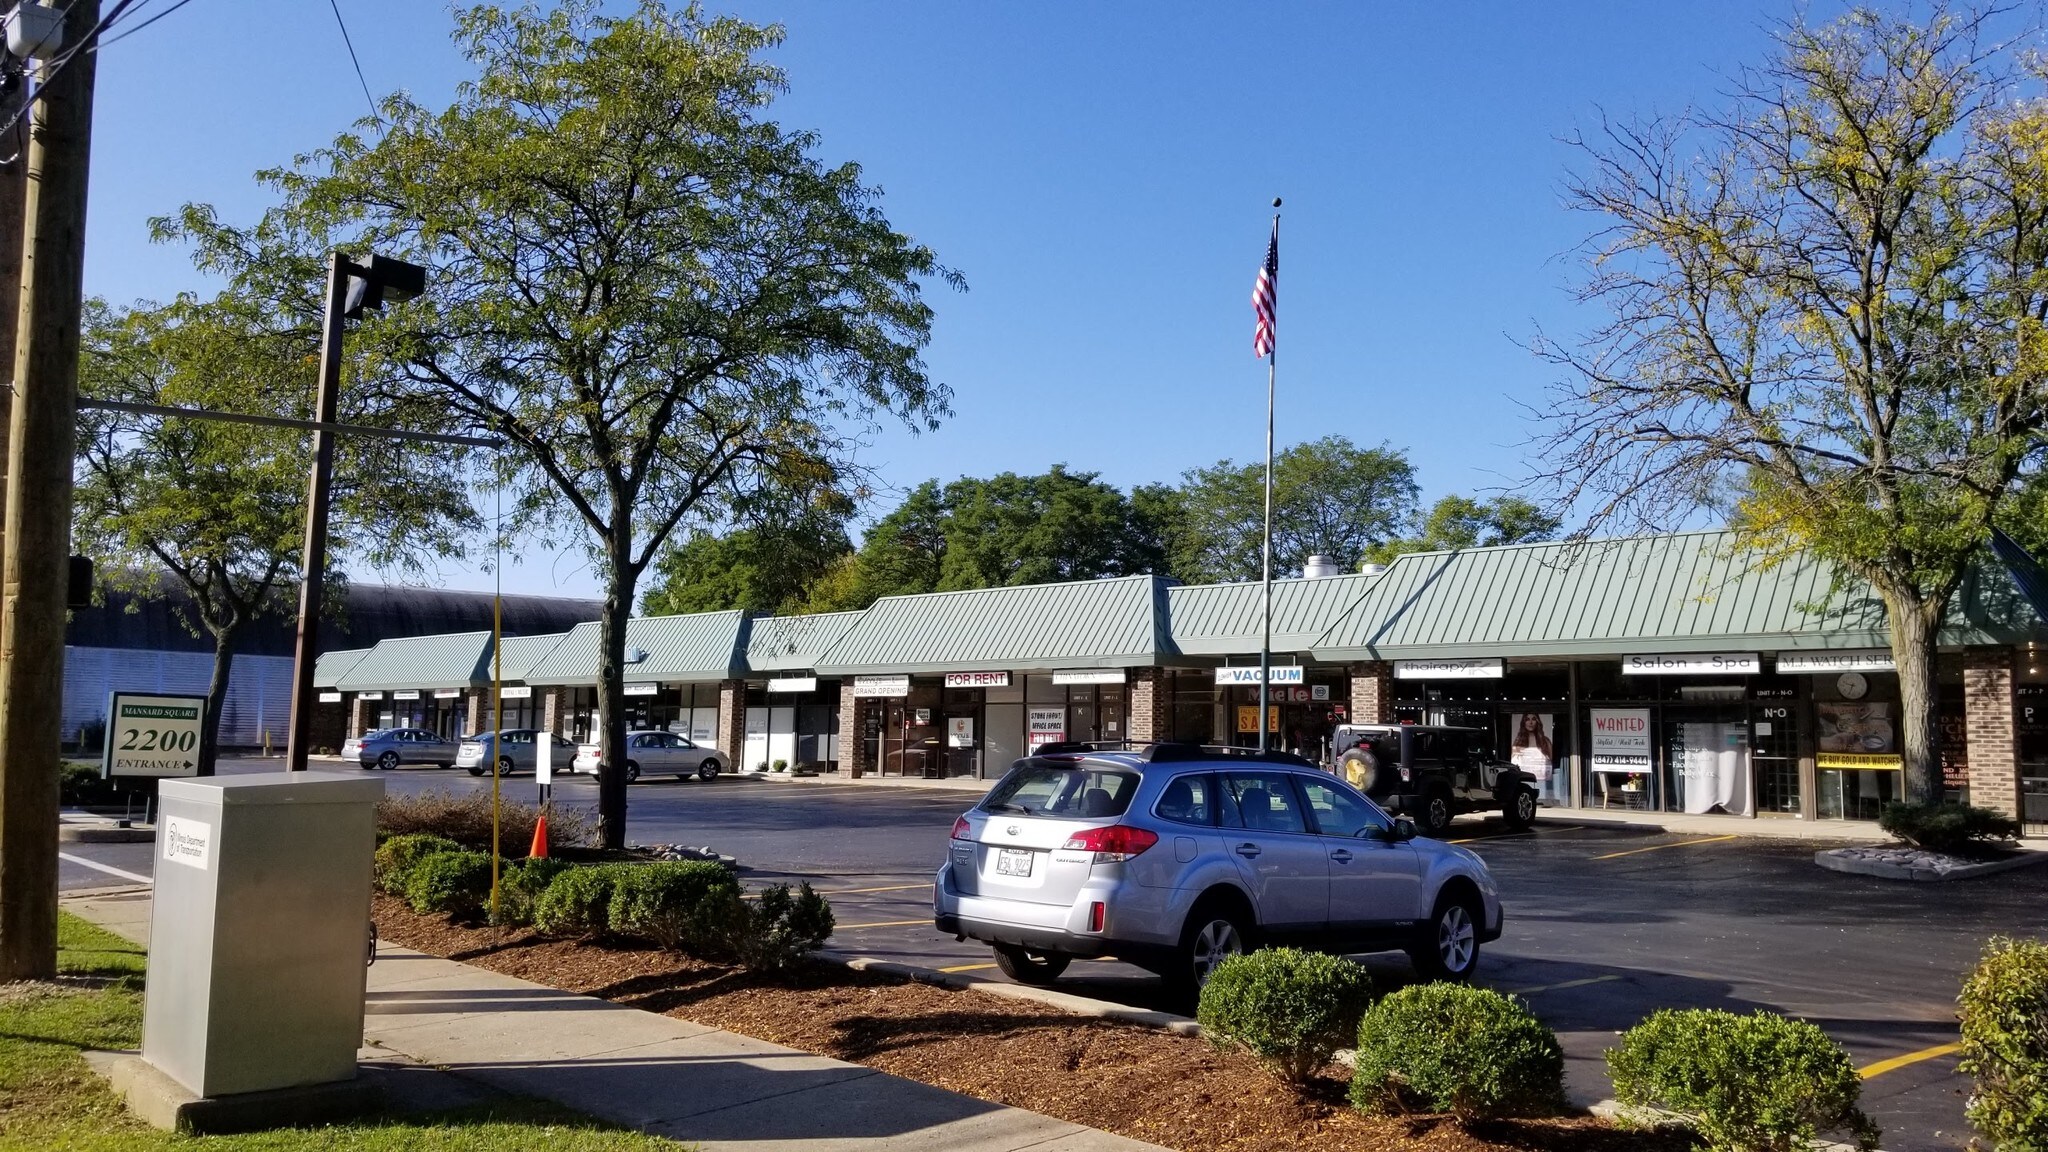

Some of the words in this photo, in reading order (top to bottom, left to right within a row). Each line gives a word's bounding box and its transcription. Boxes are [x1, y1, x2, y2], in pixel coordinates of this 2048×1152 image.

[1403, 661, 1469, 672] thairapy
[1631, 656, 1688, 669] Salon
[1711, 655, 1751, 671] Spa
[1782, 656, 1807, 668] M.J.
[1809, 655, 1861, 667] WATCH
[947, 674, 971, 686] FOR
[974, 673, 1006, 686] RENT
[855, 687, 877, 695] GRAND
[877, 686, 907, 695] OPENING
[123, 707, 163, 716] MANSARD
[163, 709, 196, 718] SQUARE
[1109, 707, 1114, 715] L
[1764, 707, 1787, 718] N-O
[2024, 707, 2034, 718] P
[1032, 722, 1047, 730] OFFICE
[1048, 722, 1062, 730] SPACE
[1241, 716, 1276, 730] SAE
[1595, 717, 1645, 732] WANTED
[119, 728, 196, 752] 2200
[1033, 733, 1044, 743] FOR
[1045, 733, 1061, 743] RENT
[116, 758, 182, 769] ENTRANCE
[1595, 755, 1613, 764] (847)
[1614, 756, 1647, 765] 414-9444
[1817, 755, 1827, 764] WE
[1828, 755, 1841, 764] BUY
[1841, 755, 1857, 765] GOLD
[1858, 756, 1871, 765] AND
[1871, 756, 1900, 766] WATCHES
